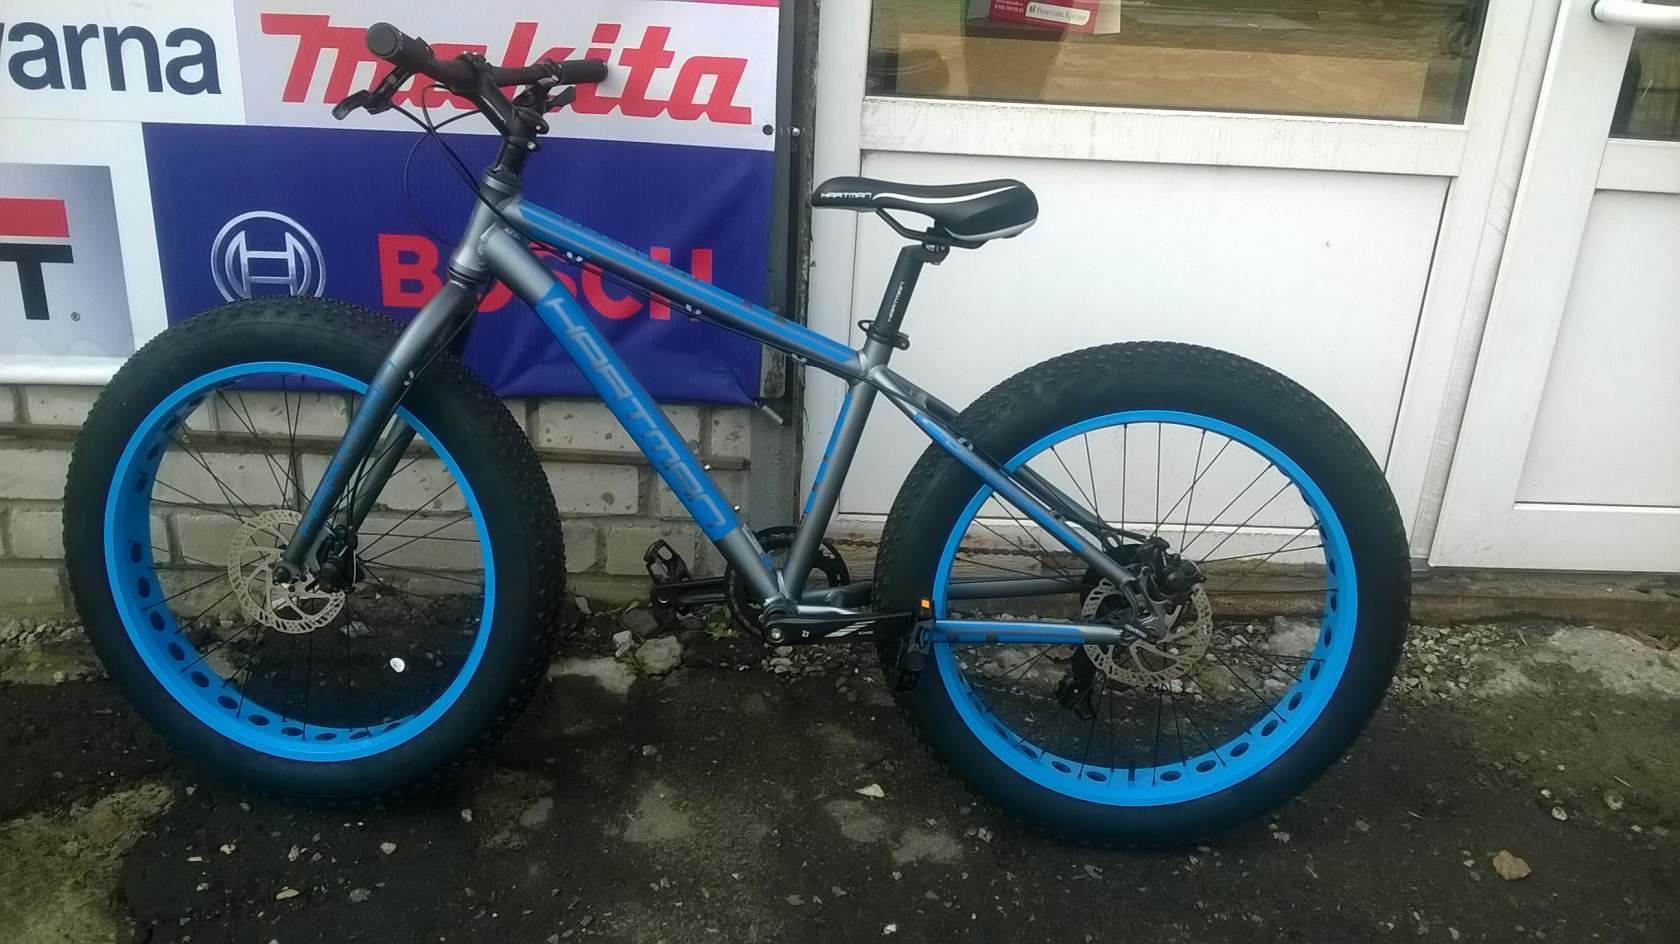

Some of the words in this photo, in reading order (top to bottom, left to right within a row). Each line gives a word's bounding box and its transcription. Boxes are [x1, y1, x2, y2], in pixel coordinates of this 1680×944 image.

[0, 22, 222, 95] arna
[820, 191, 872, 199] HARTMAN
[544, 298, 727, 527] HARTMAN
